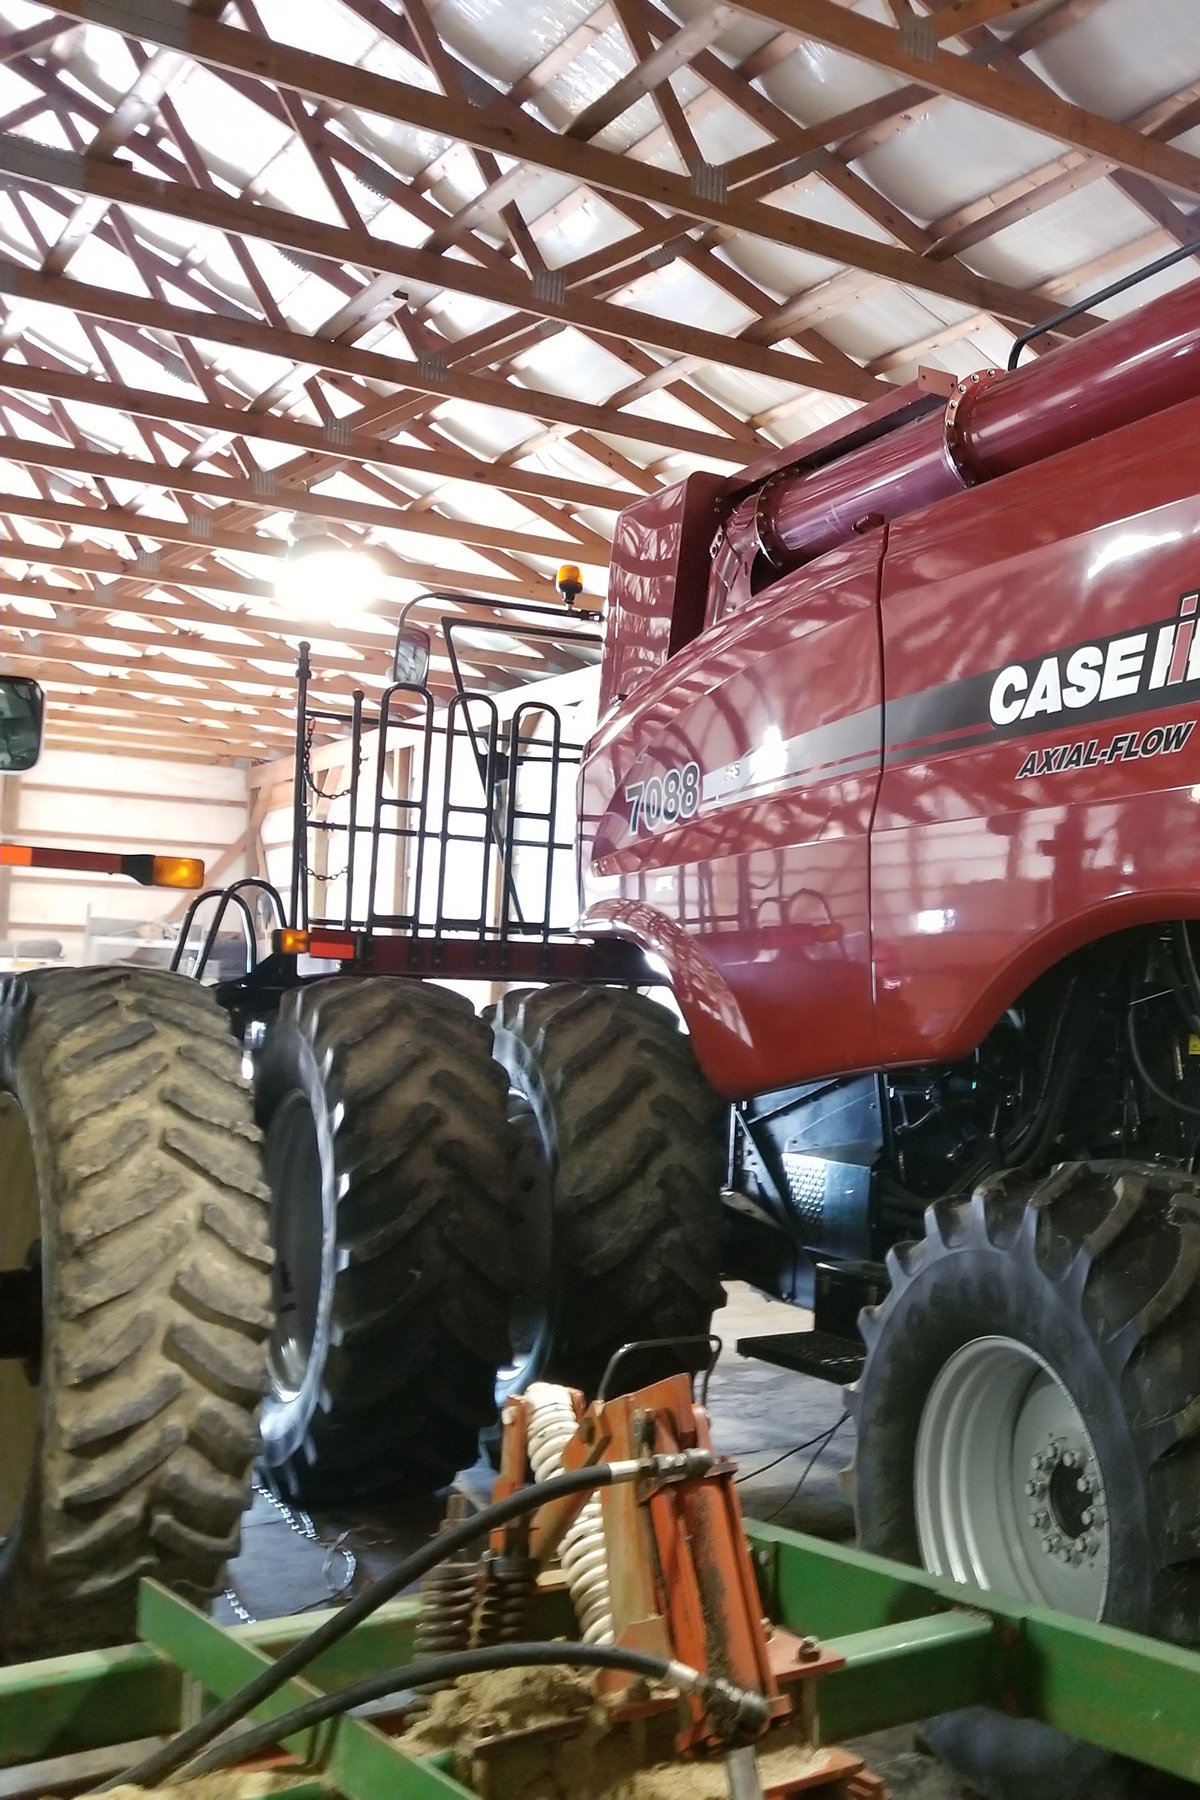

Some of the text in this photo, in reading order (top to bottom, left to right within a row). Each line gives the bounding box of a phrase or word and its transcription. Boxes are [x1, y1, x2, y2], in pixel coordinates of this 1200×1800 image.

[989, 633, 1148, 725] CASE
[1015, 720, 1198, 779] AXIAL-FLOW
[625, 761, 700, 836] 7088
